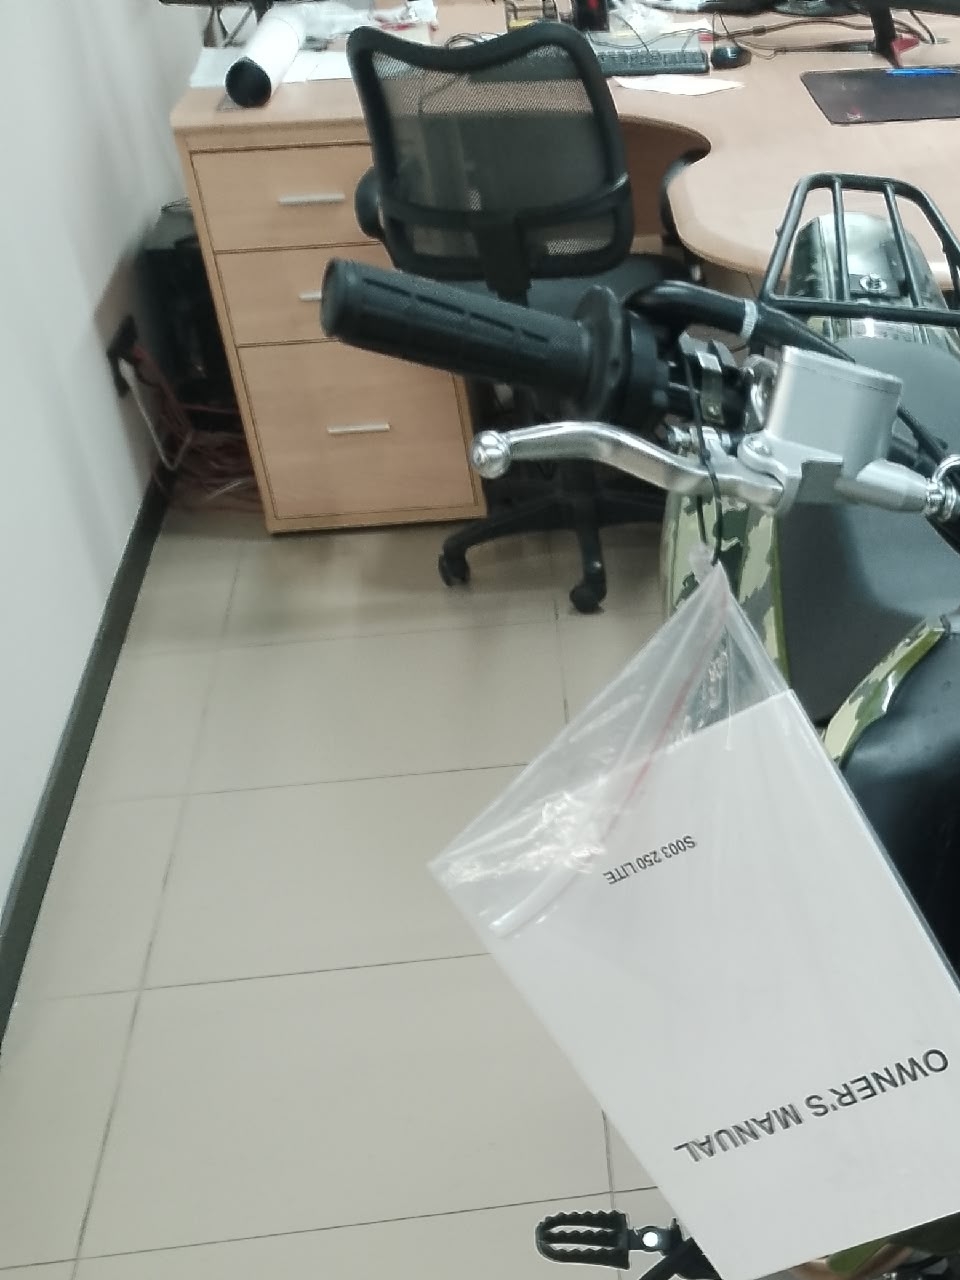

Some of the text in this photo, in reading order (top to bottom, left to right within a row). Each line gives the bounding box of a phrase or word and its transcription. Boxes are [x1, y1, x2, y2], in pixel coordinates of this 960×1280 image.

[603, 835, 697, 885] S003 250 LITE
[673, 1048, 949, 1162] OWNER'S MANUAL
